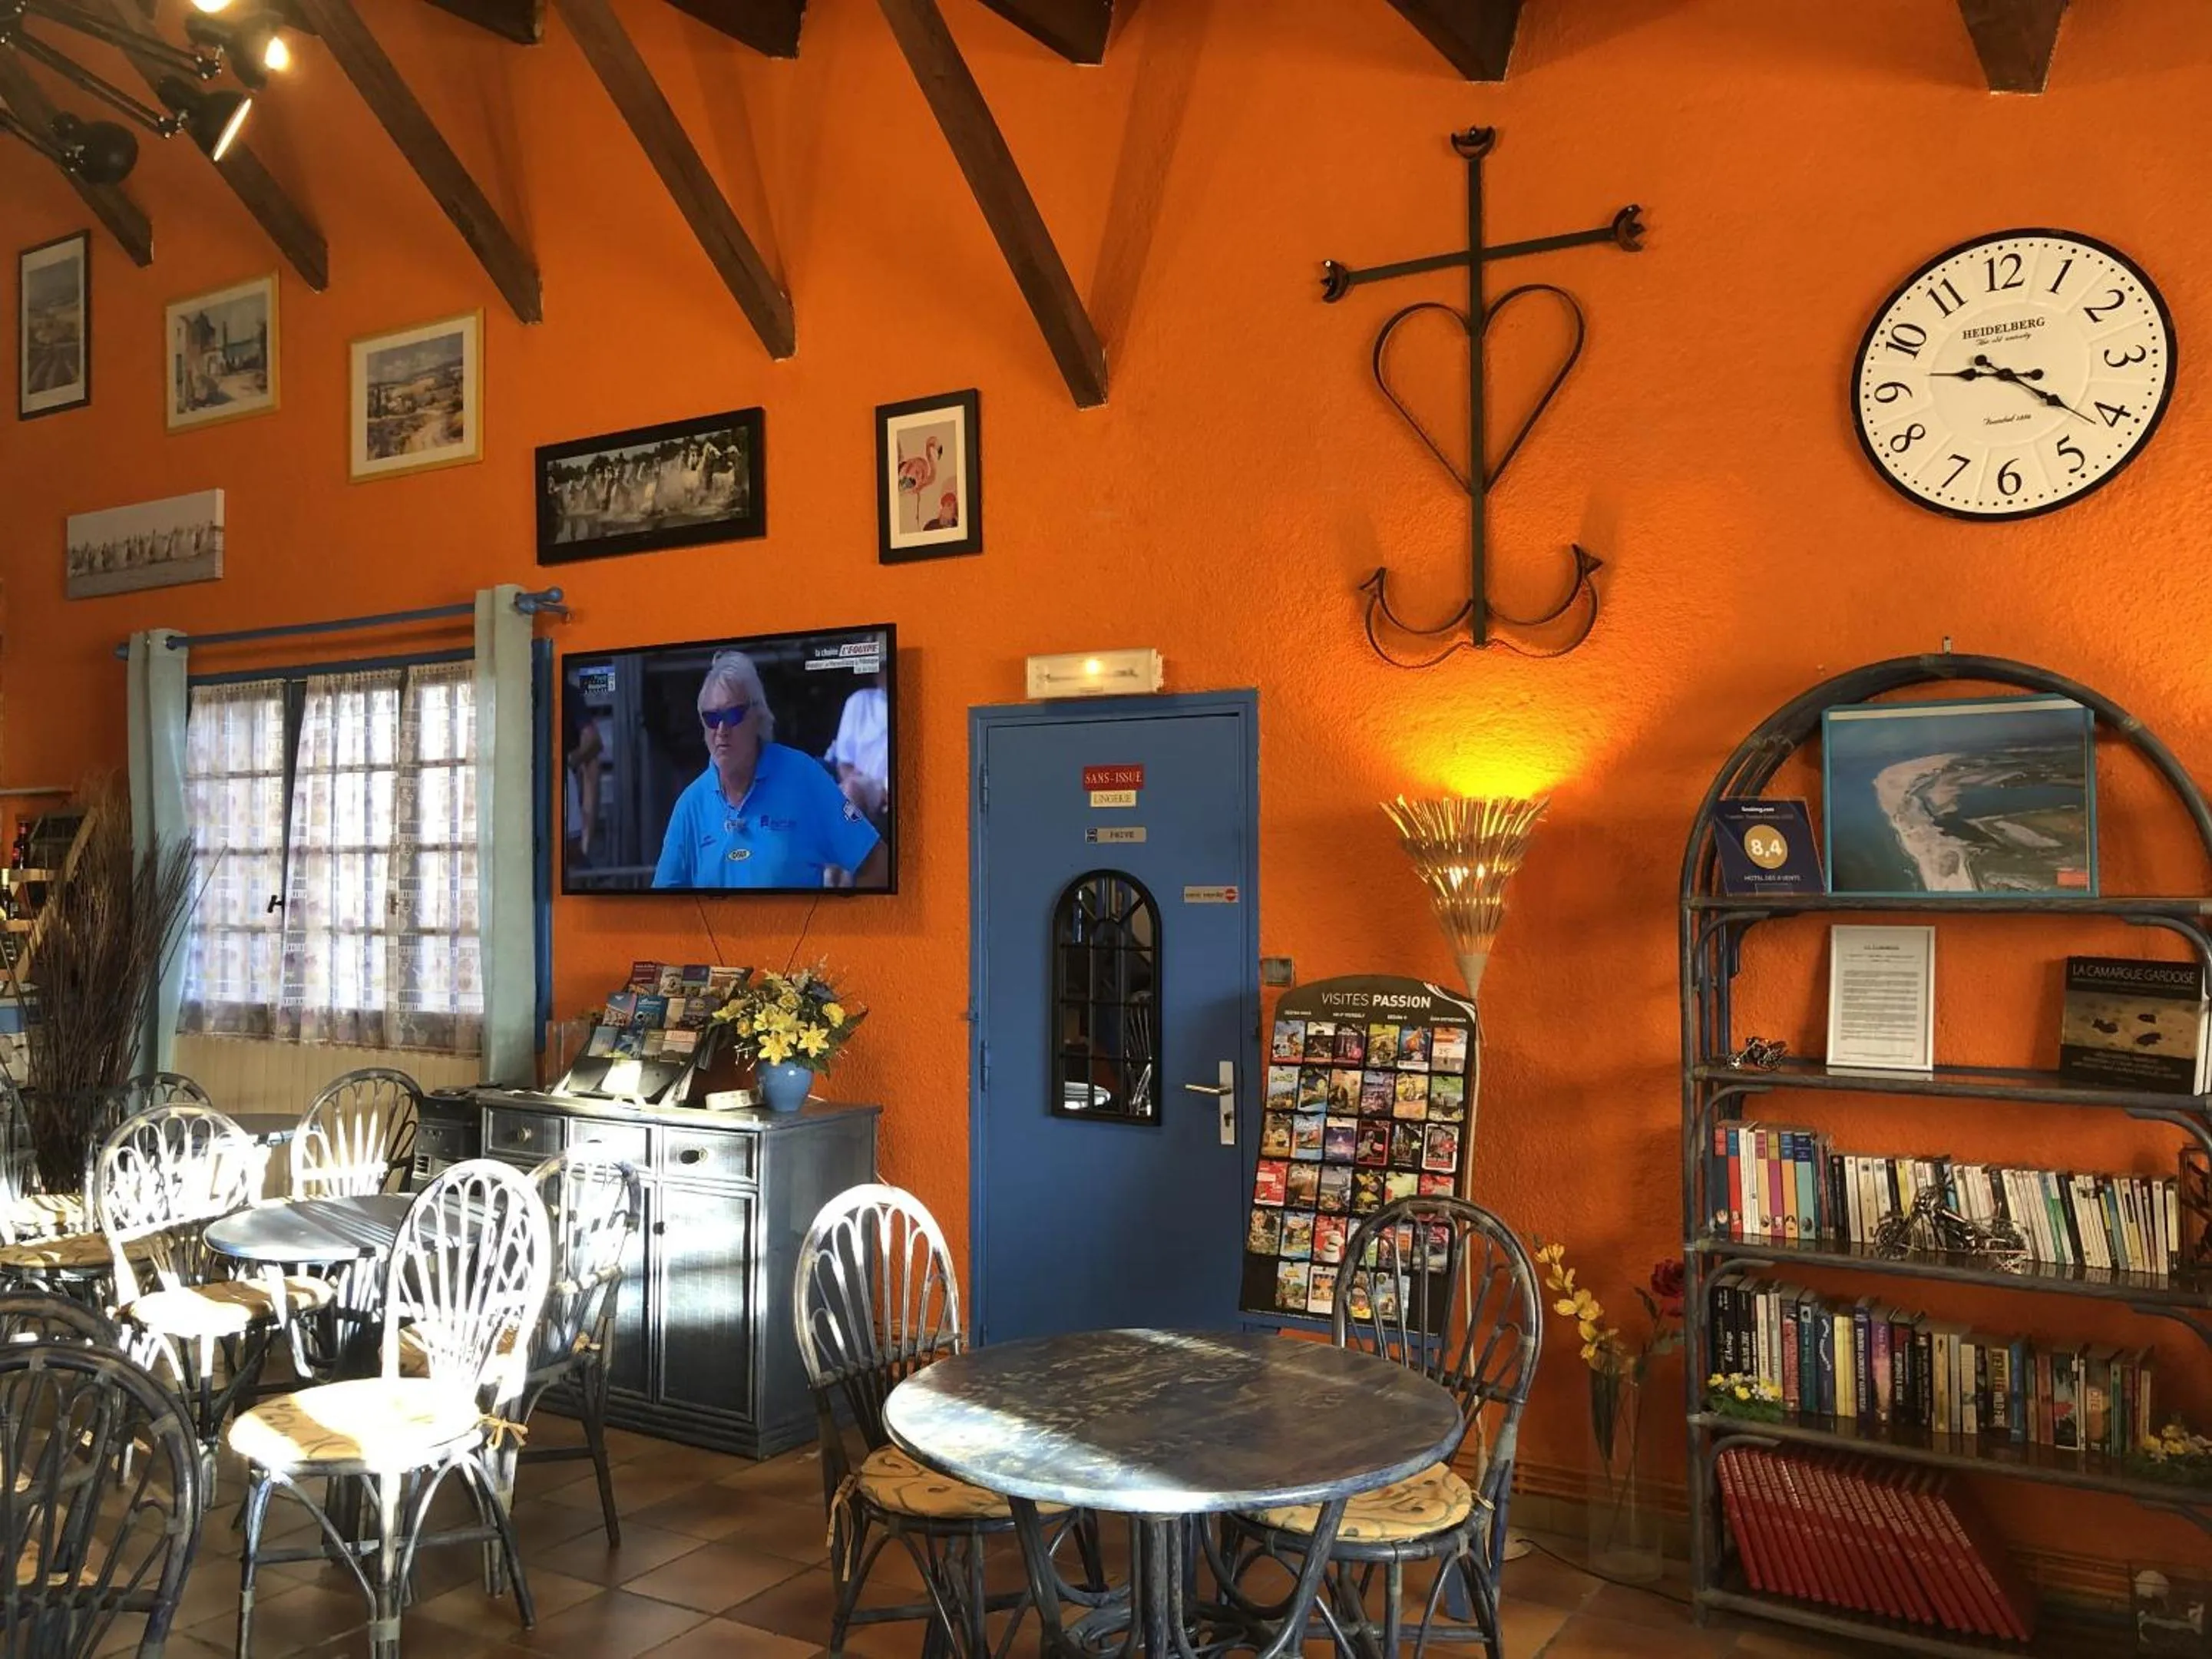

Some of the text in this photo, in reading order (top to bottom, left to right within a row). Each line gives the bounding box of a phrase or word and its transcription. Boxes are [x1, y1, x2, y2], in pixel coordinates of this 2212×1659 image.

[1984, 253, 2025, 292] 12
[2046, 259, 2072, 294] 1
[1926, 279, 1968, 319] 11
[2084, 289, 2124, 323] 2
[1886, 323, 1926, 360] 10
[1962, 316, 2045, 339] HEIDELBERG
[2104, 345, 2146, 368] 3
[1874, 382, 1913, 404] 9
[2095, 400, 2131, 428] 4
[1890, 424, 1926, 452] 8
[2056, 435, 2085, 473] 5
[1942, 454, 1971, 487] 7
[1998, 458, 2022, 495] 6
[1085, 771, 1142, 783] SANS-ISSUE
[1751, 839, 1783, 857] 8,4
[2073, 964, 2085, 976] LA
[2088, 965, 2143, 980] CAMARGUE
[2145, 969, 2195, 984] GARDOISE
[1321, 993, 1430, 1009] VISITES PASSION
